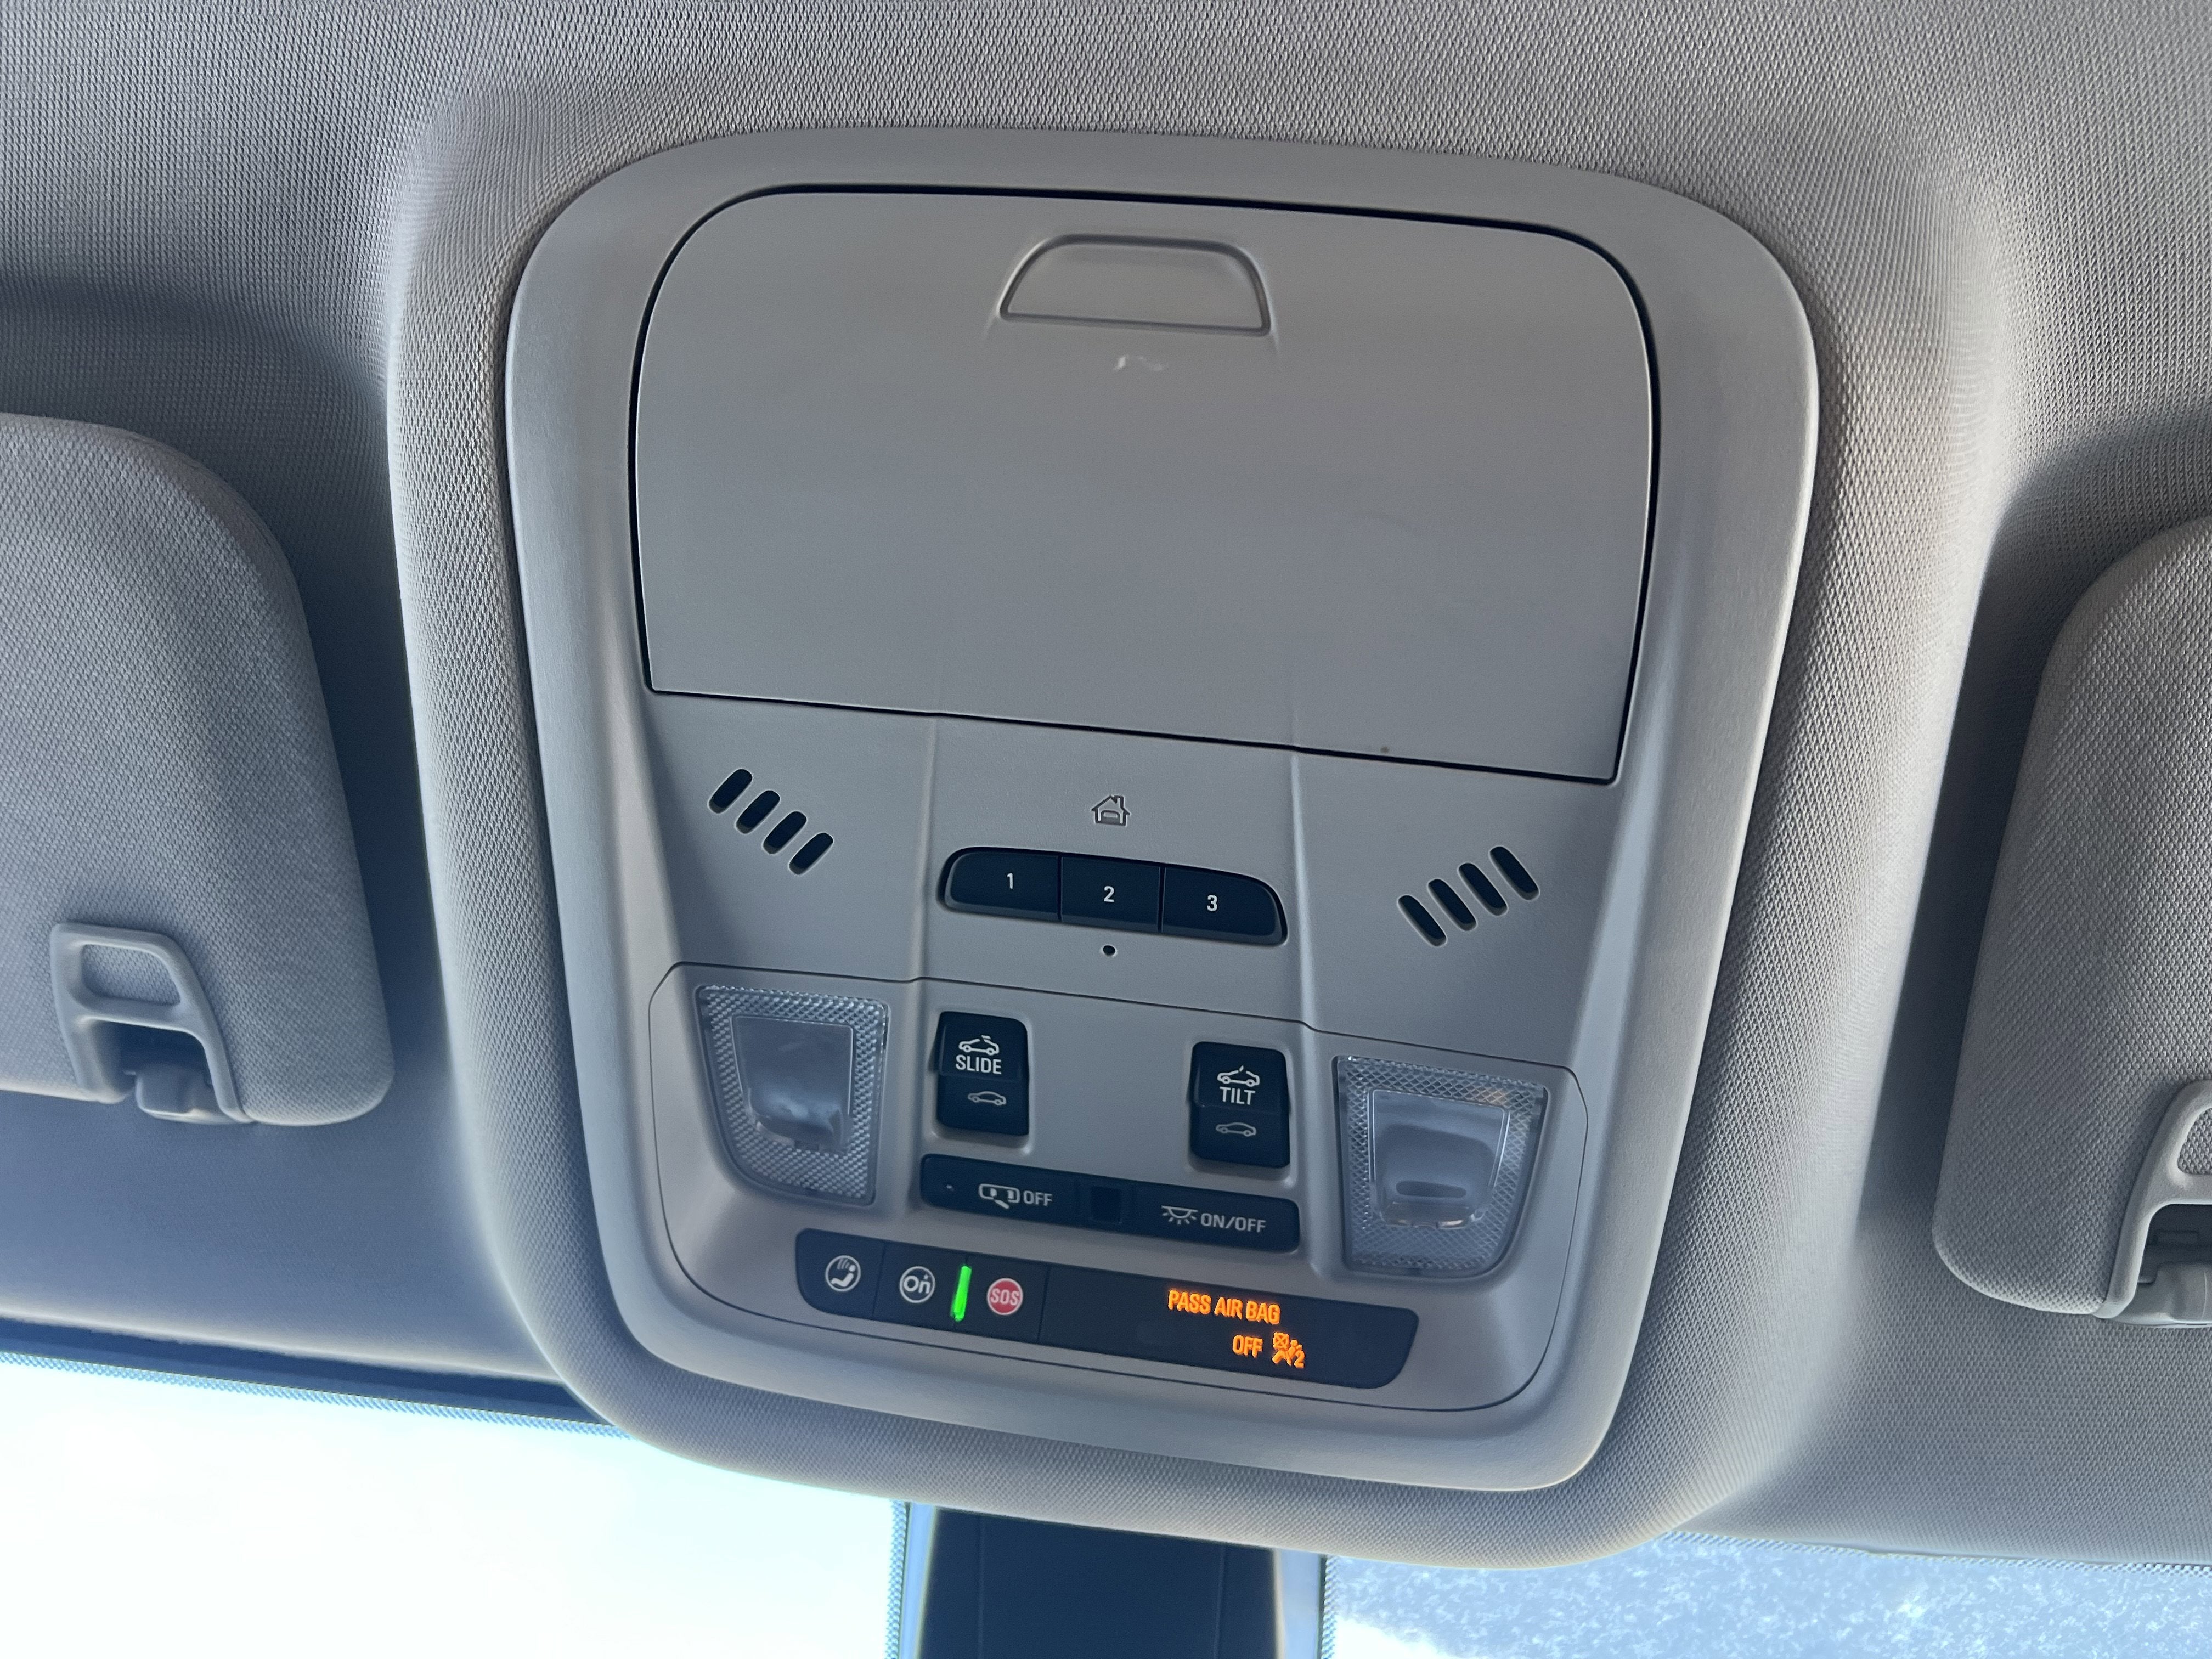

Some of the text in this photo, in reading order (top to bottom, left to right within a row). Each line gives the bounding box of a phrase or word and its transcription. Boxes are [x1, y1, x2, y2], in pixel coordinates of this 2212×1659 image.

[1007, 873, 1014, 889] 1
[1104, 885, 1114, 902] 2
[1206, 895, 1218, 911] 3
[955, 1054, 1002, 1075] SLIDE
[1220, 1086, 1256, 1105] TILT
[1023, 1190, 1053, 1206] OFF
[1200, 1212, 1266, 1233] ON/OFF
[903, 1274, 931, 1294] On
[990, 1288, 1020, 1306] SOS
[1167, 1289, 1280, 1325] PASS AIR BAG
[1232, 1335, 1263, 1358] OFF
